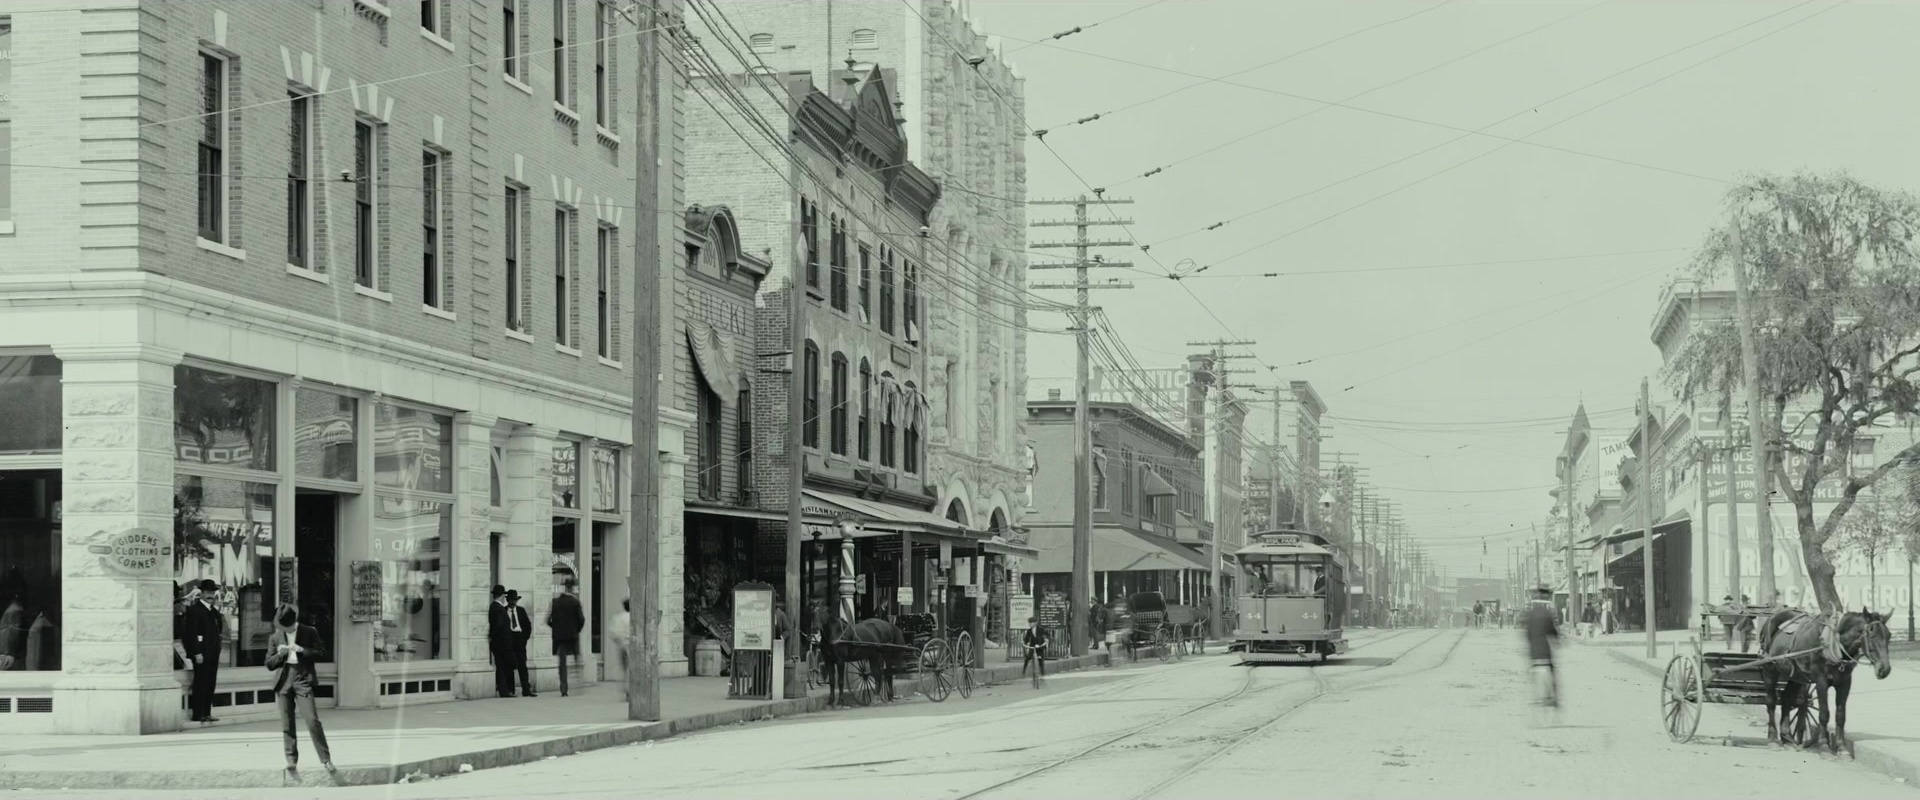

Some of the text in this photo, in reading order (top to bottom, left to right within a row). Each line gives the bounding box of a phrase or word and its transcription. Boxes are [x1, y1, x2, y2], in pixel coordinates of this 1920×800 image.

[1601, 440, 1631, 456] TAMP
[1706, 463, 1755, 475] HLS
[118, 534, 158, 546] GIDDENS
[115, 547, 158, 556] CLOTHING
[117, 556, 157, 569] CORNER
[1784, 585, 1850, 608] CAH
